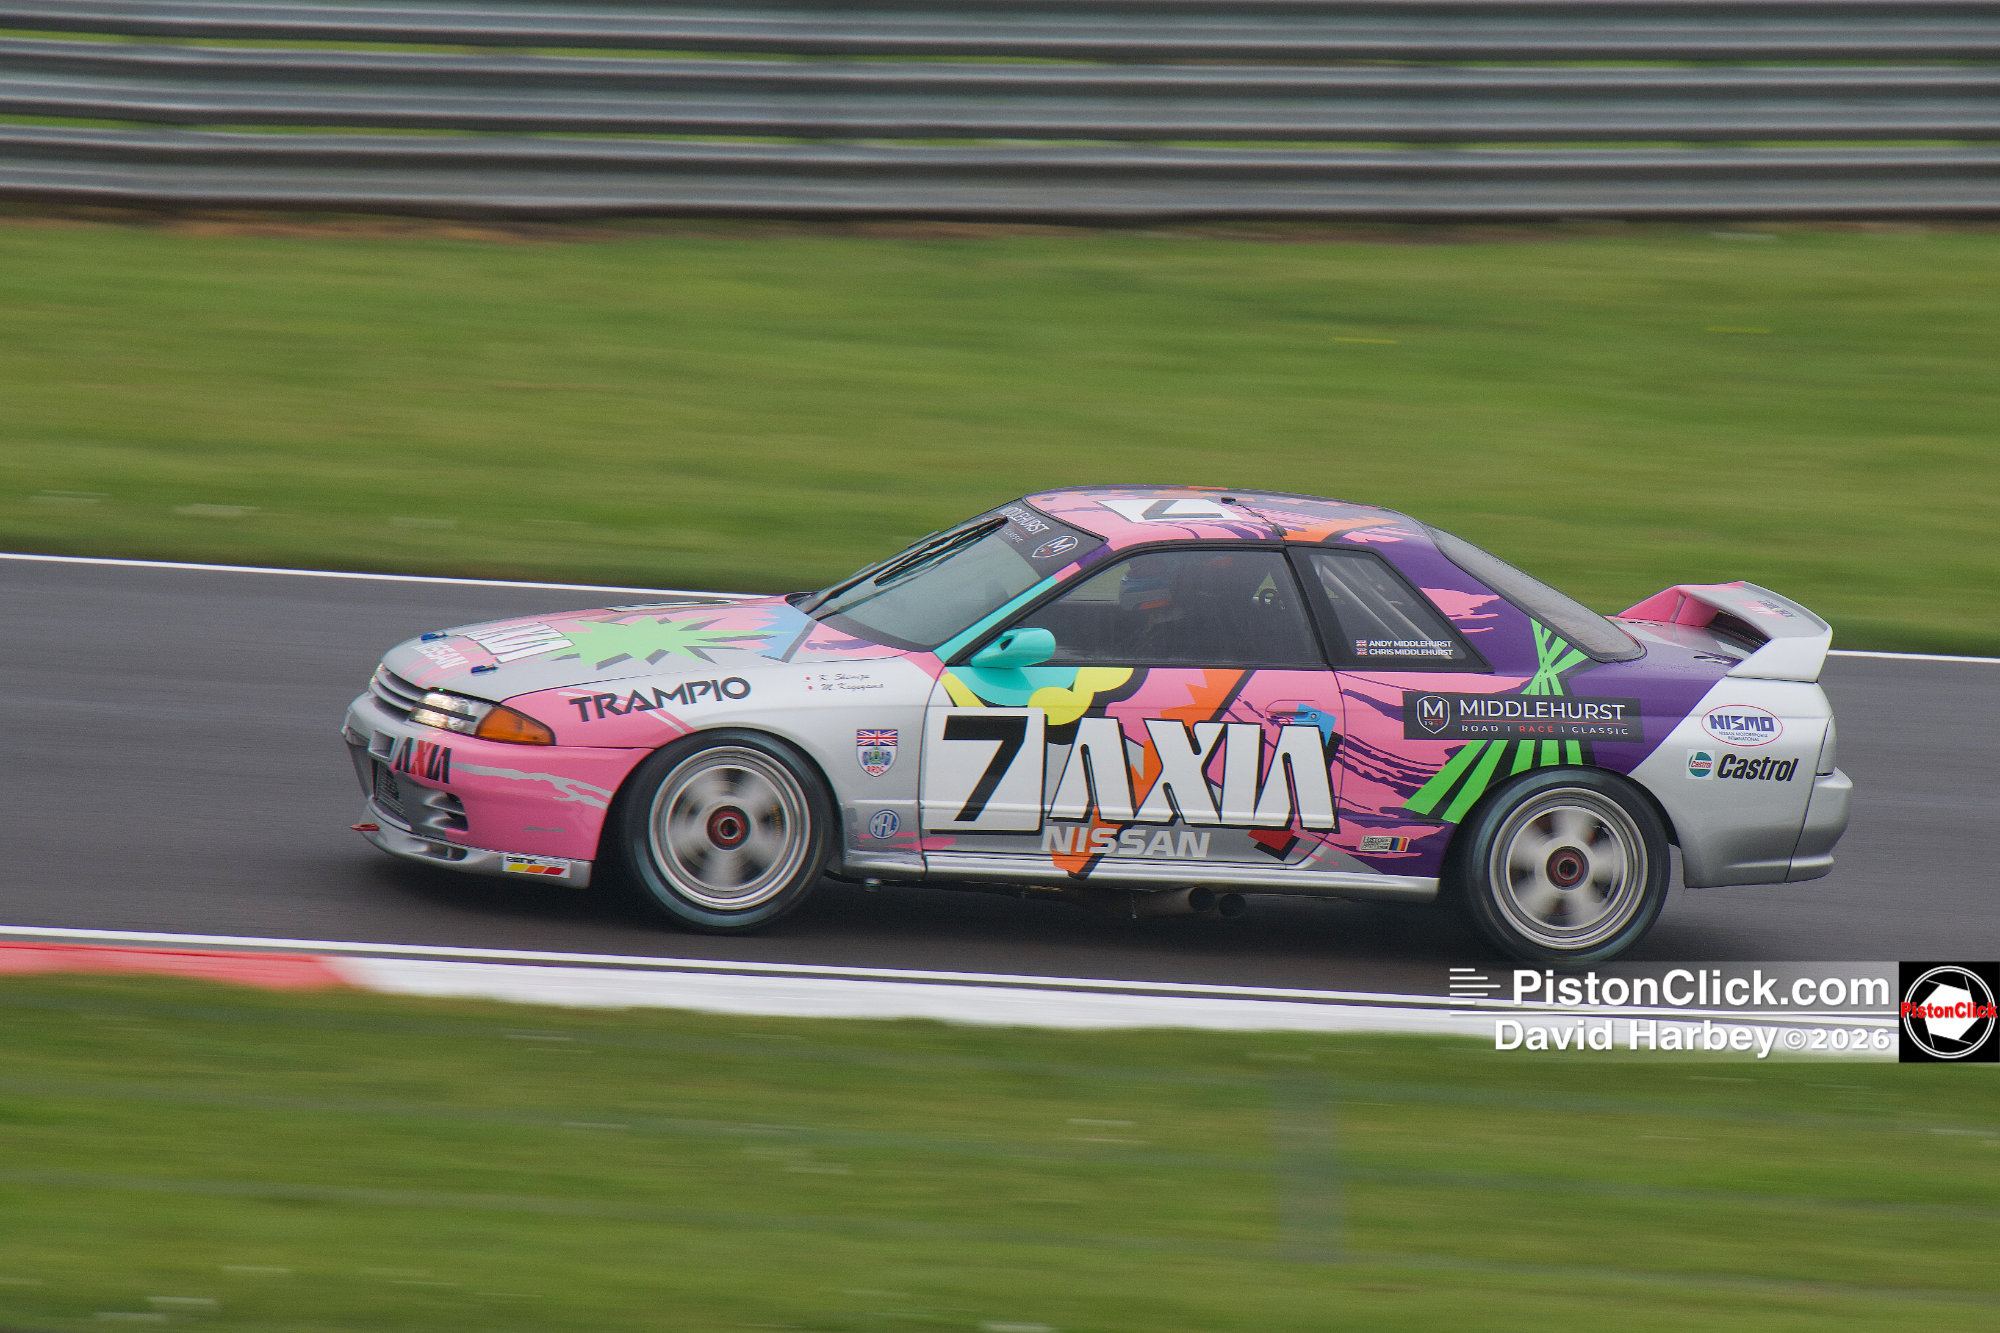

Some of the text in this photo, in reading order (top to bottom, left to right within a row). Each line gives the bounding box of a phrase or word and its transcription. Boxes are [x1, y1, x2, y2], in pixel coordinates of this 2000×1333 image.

[1368, 648, 1394, 656] CHRIS
[1393, 640, 1452, 648] MIDDLEHURST
[569, 676, 751, 722] TRAMPIO
[1459, 699, 1625, 720] MIDDLEHURST
[1519, 725, 1554, 733] RACE
[1571, 726, 1628, 735] CLASSIC
[1709, 714, 1775, 732] NISMO
[943, 715, 1029, 822] 7
[1048, 716, 1339, 831] AXIA
[1690, 760, 1712, 769] Castrol
[1717, 753, 1799, 782] Castrol
[1041, 826, 1211, 857] NISSAN
